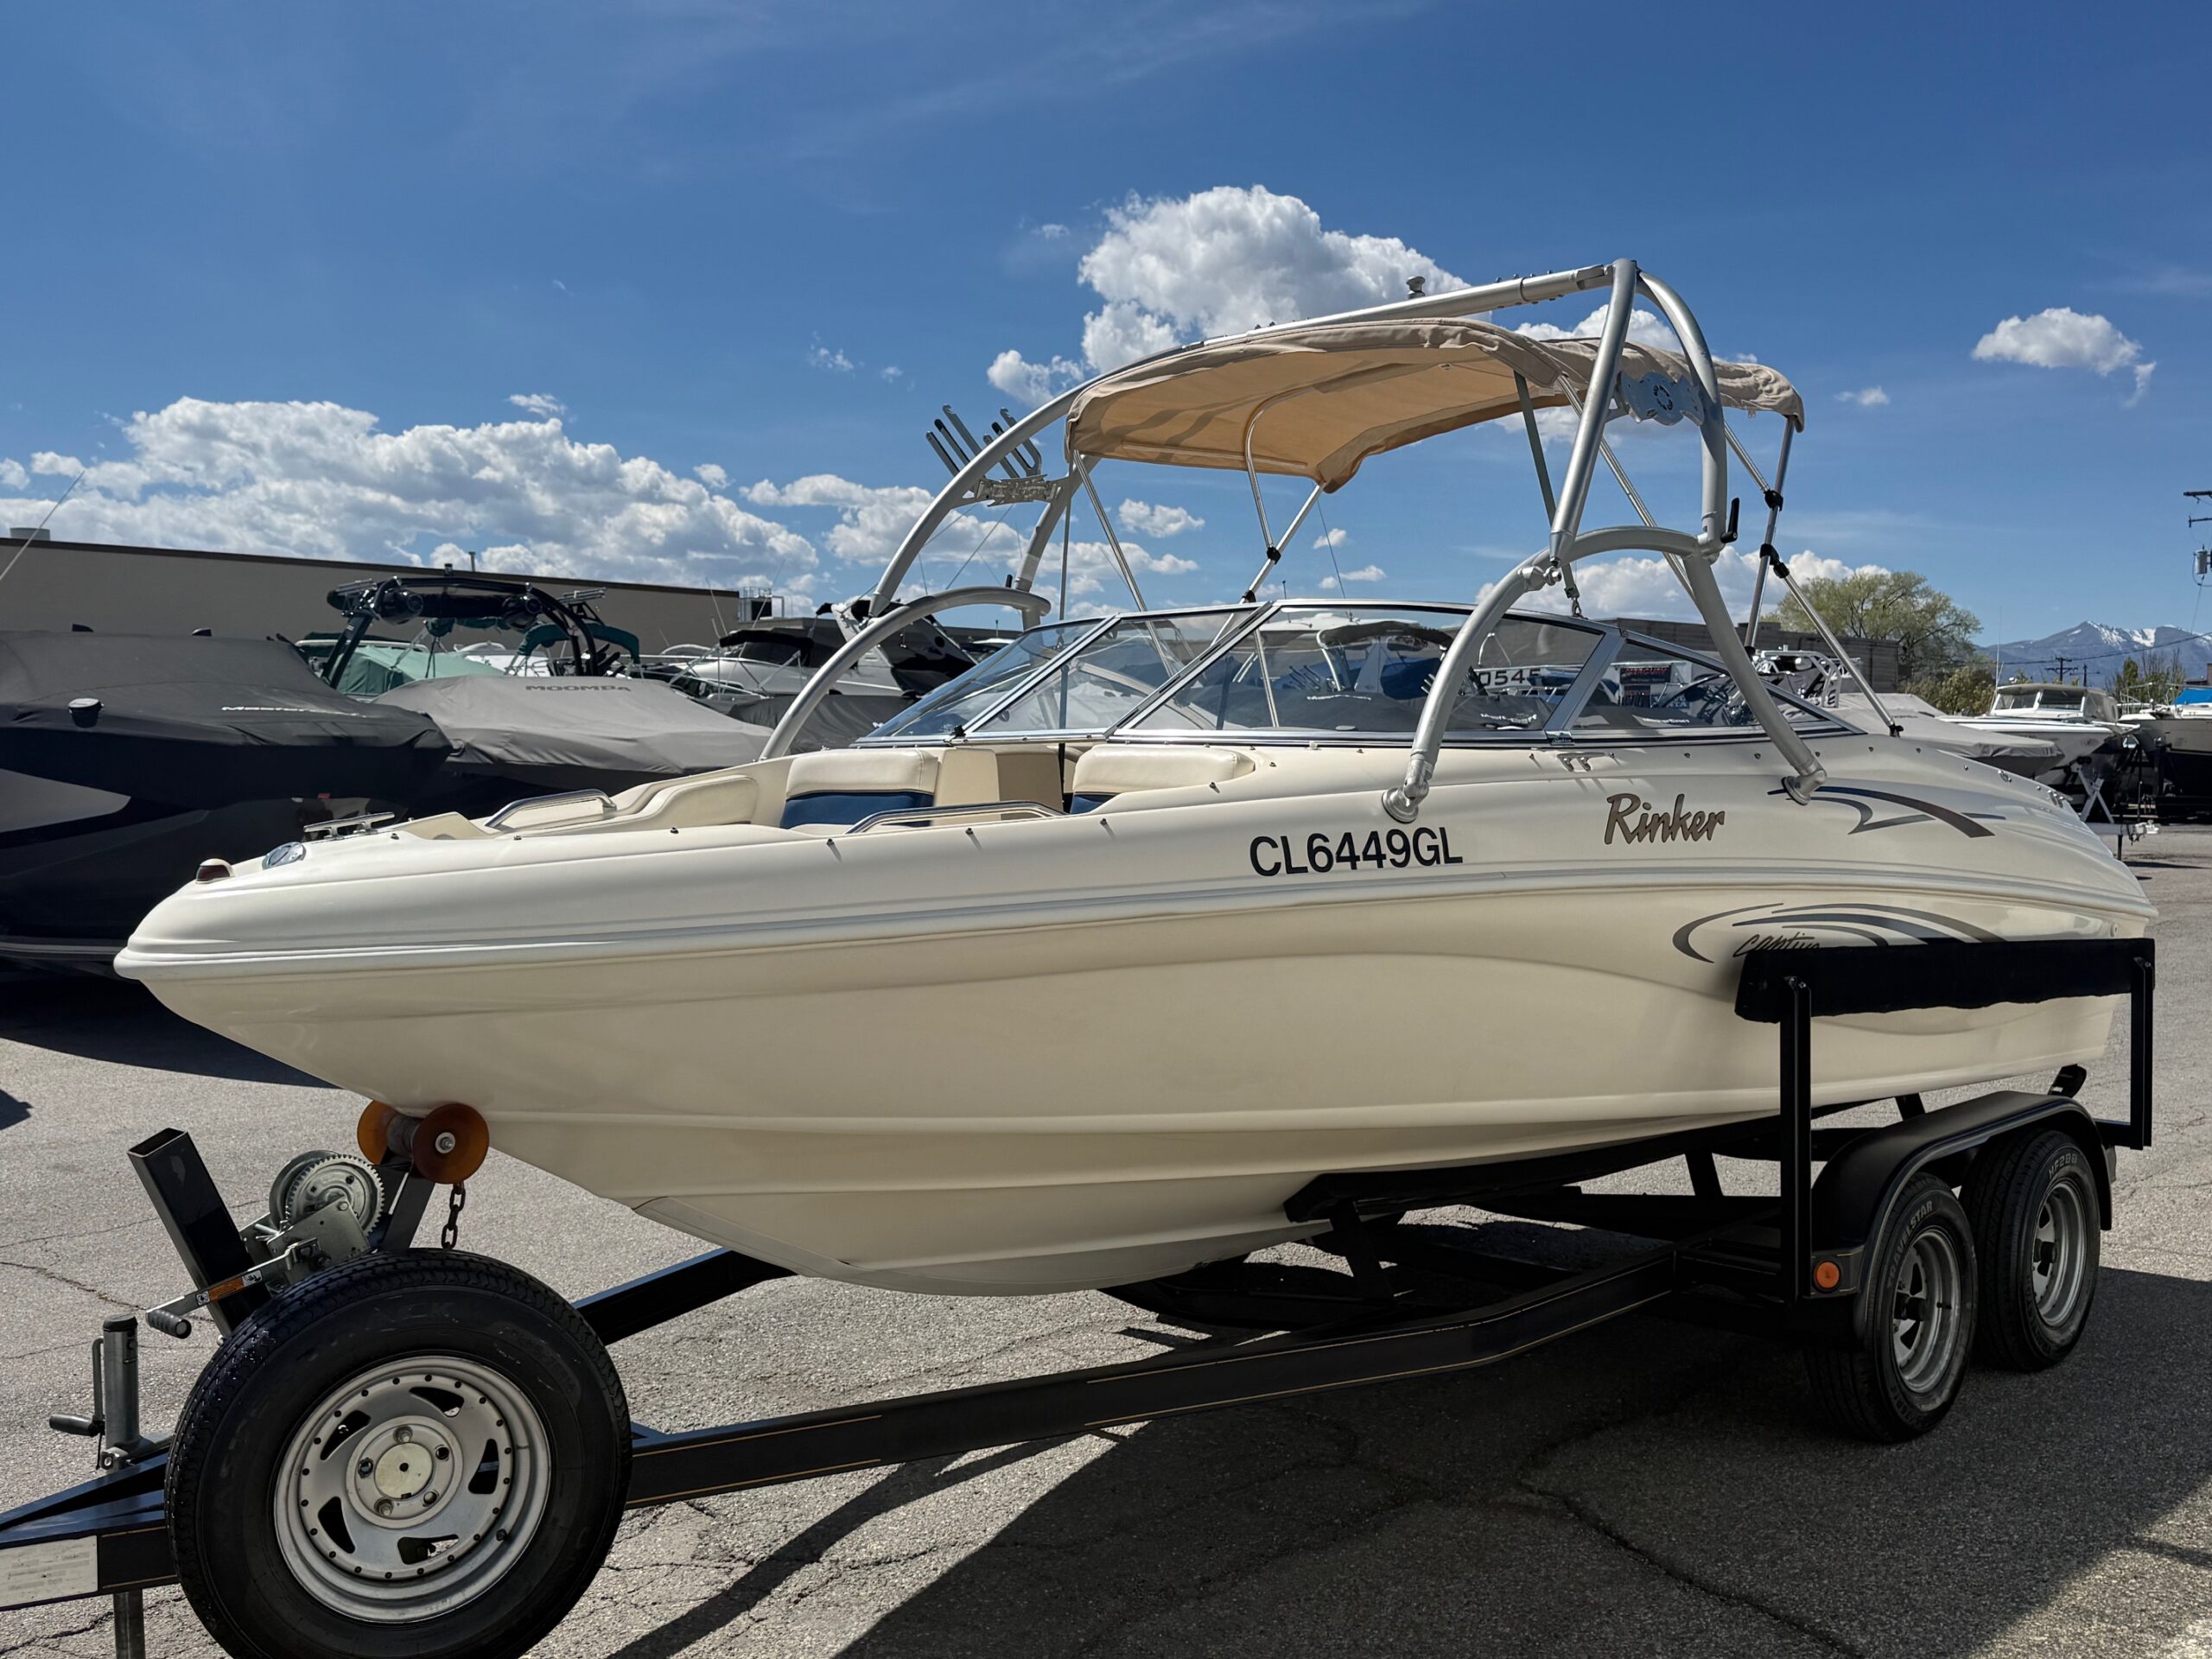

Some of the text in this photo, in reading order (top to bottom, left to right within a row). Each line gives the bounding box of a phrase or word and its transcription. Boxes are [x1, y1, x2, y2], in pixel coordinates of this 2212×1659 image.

[1604, 793, 1726, 844] Rinker
[1249, 827, 1464, 877] CL6449GL
[1886, 1200, 1933, 1289] TRAVELSTAR
